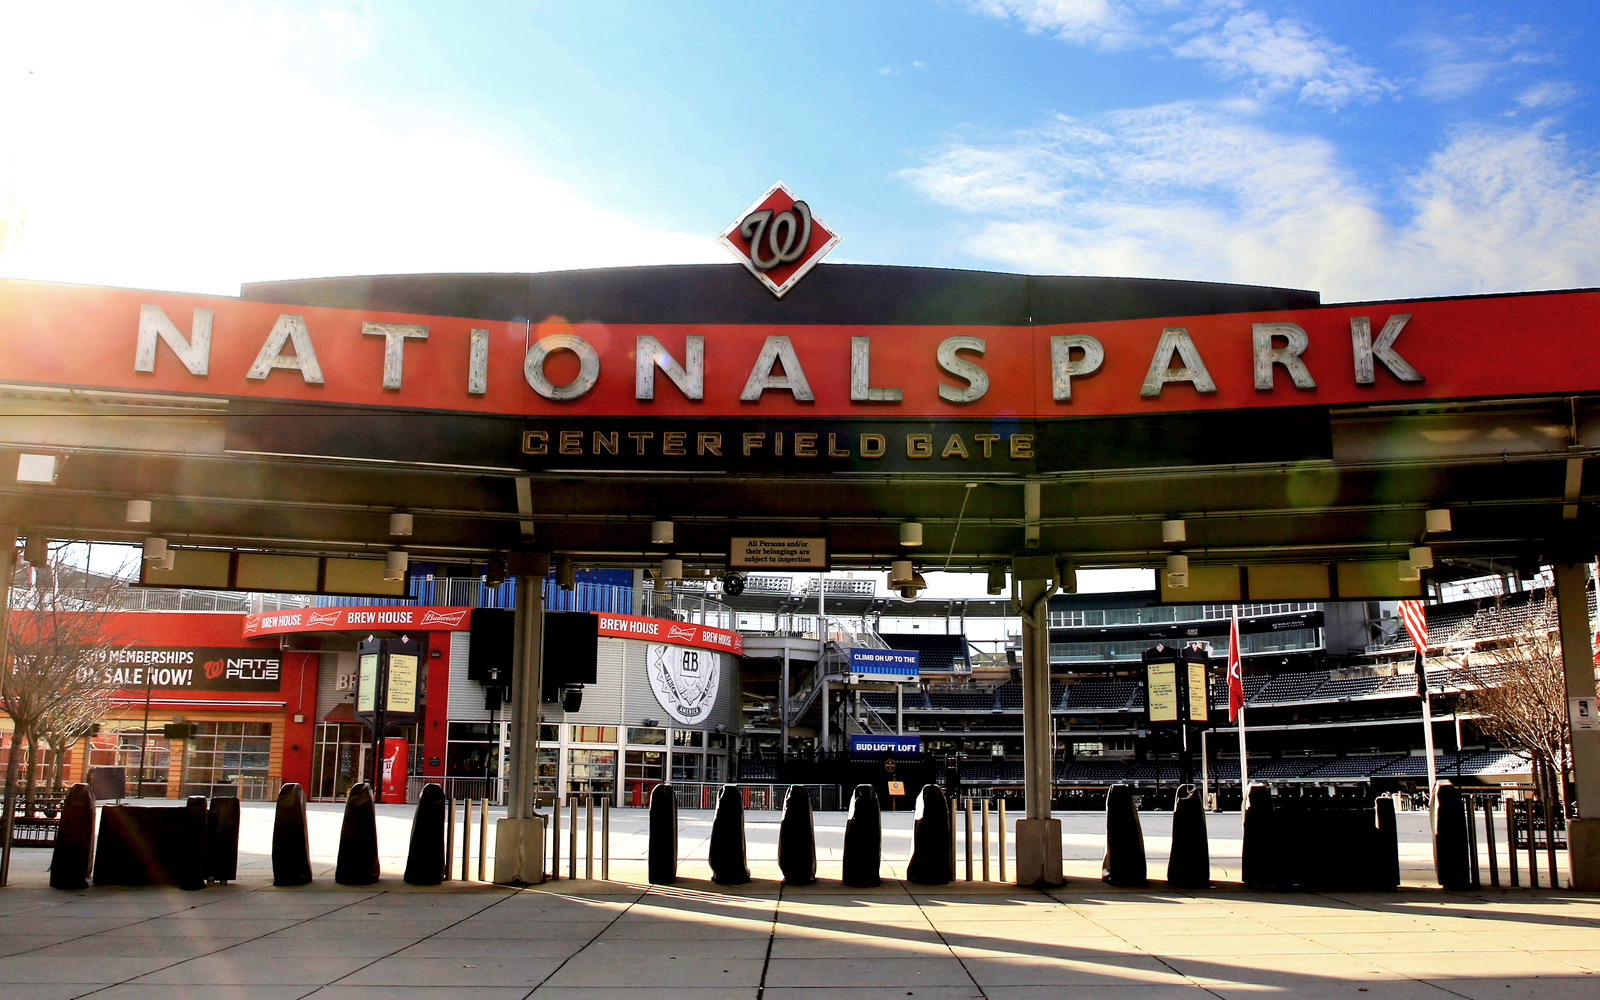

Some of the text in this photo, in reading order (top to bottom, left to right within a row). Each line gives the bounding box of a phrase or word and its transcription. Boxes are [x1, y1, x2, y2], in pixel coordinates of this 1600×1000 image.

[134, 303, 1426, 403] NATIONALS PARK
[522, 430, 1034, 460] CENTER FIELD GATE
[763, 548, 797, 556] belongings
[744, 556, 767, 564] subject
[778, 556, 811, 564] inspection
[261, 617, 278, 629] BREW
[278, 614, 302, 627] HOUSE
[309, 615, 337, 623] Budweiser
[347, 611, 413, 624] BREW HOUSE
[424, 613, 461, 622] Budweiser
[600, 617, 659, 635] BREW HOUSE
[702, 630, 718, 643] BREW
[718, 633, 732, 647] HOUSE
[109, 650, 194, 664] MEMBERSHIPS
[226, 658, 280, 669] NATS
[682, 650, 699, 672] AB
[853, 653, 874, 661] CLIMB
[874, 654, 884, 662] ON
[903, 656, 916, 664] THE
[104, 667, 143, 685] SALE
[146, 668, 193, 686] NOW!
[226, 669, 279, 680] PLUS
[856, 743, 873, 751] BUD
[897, 744, 917, 752] LOFT
